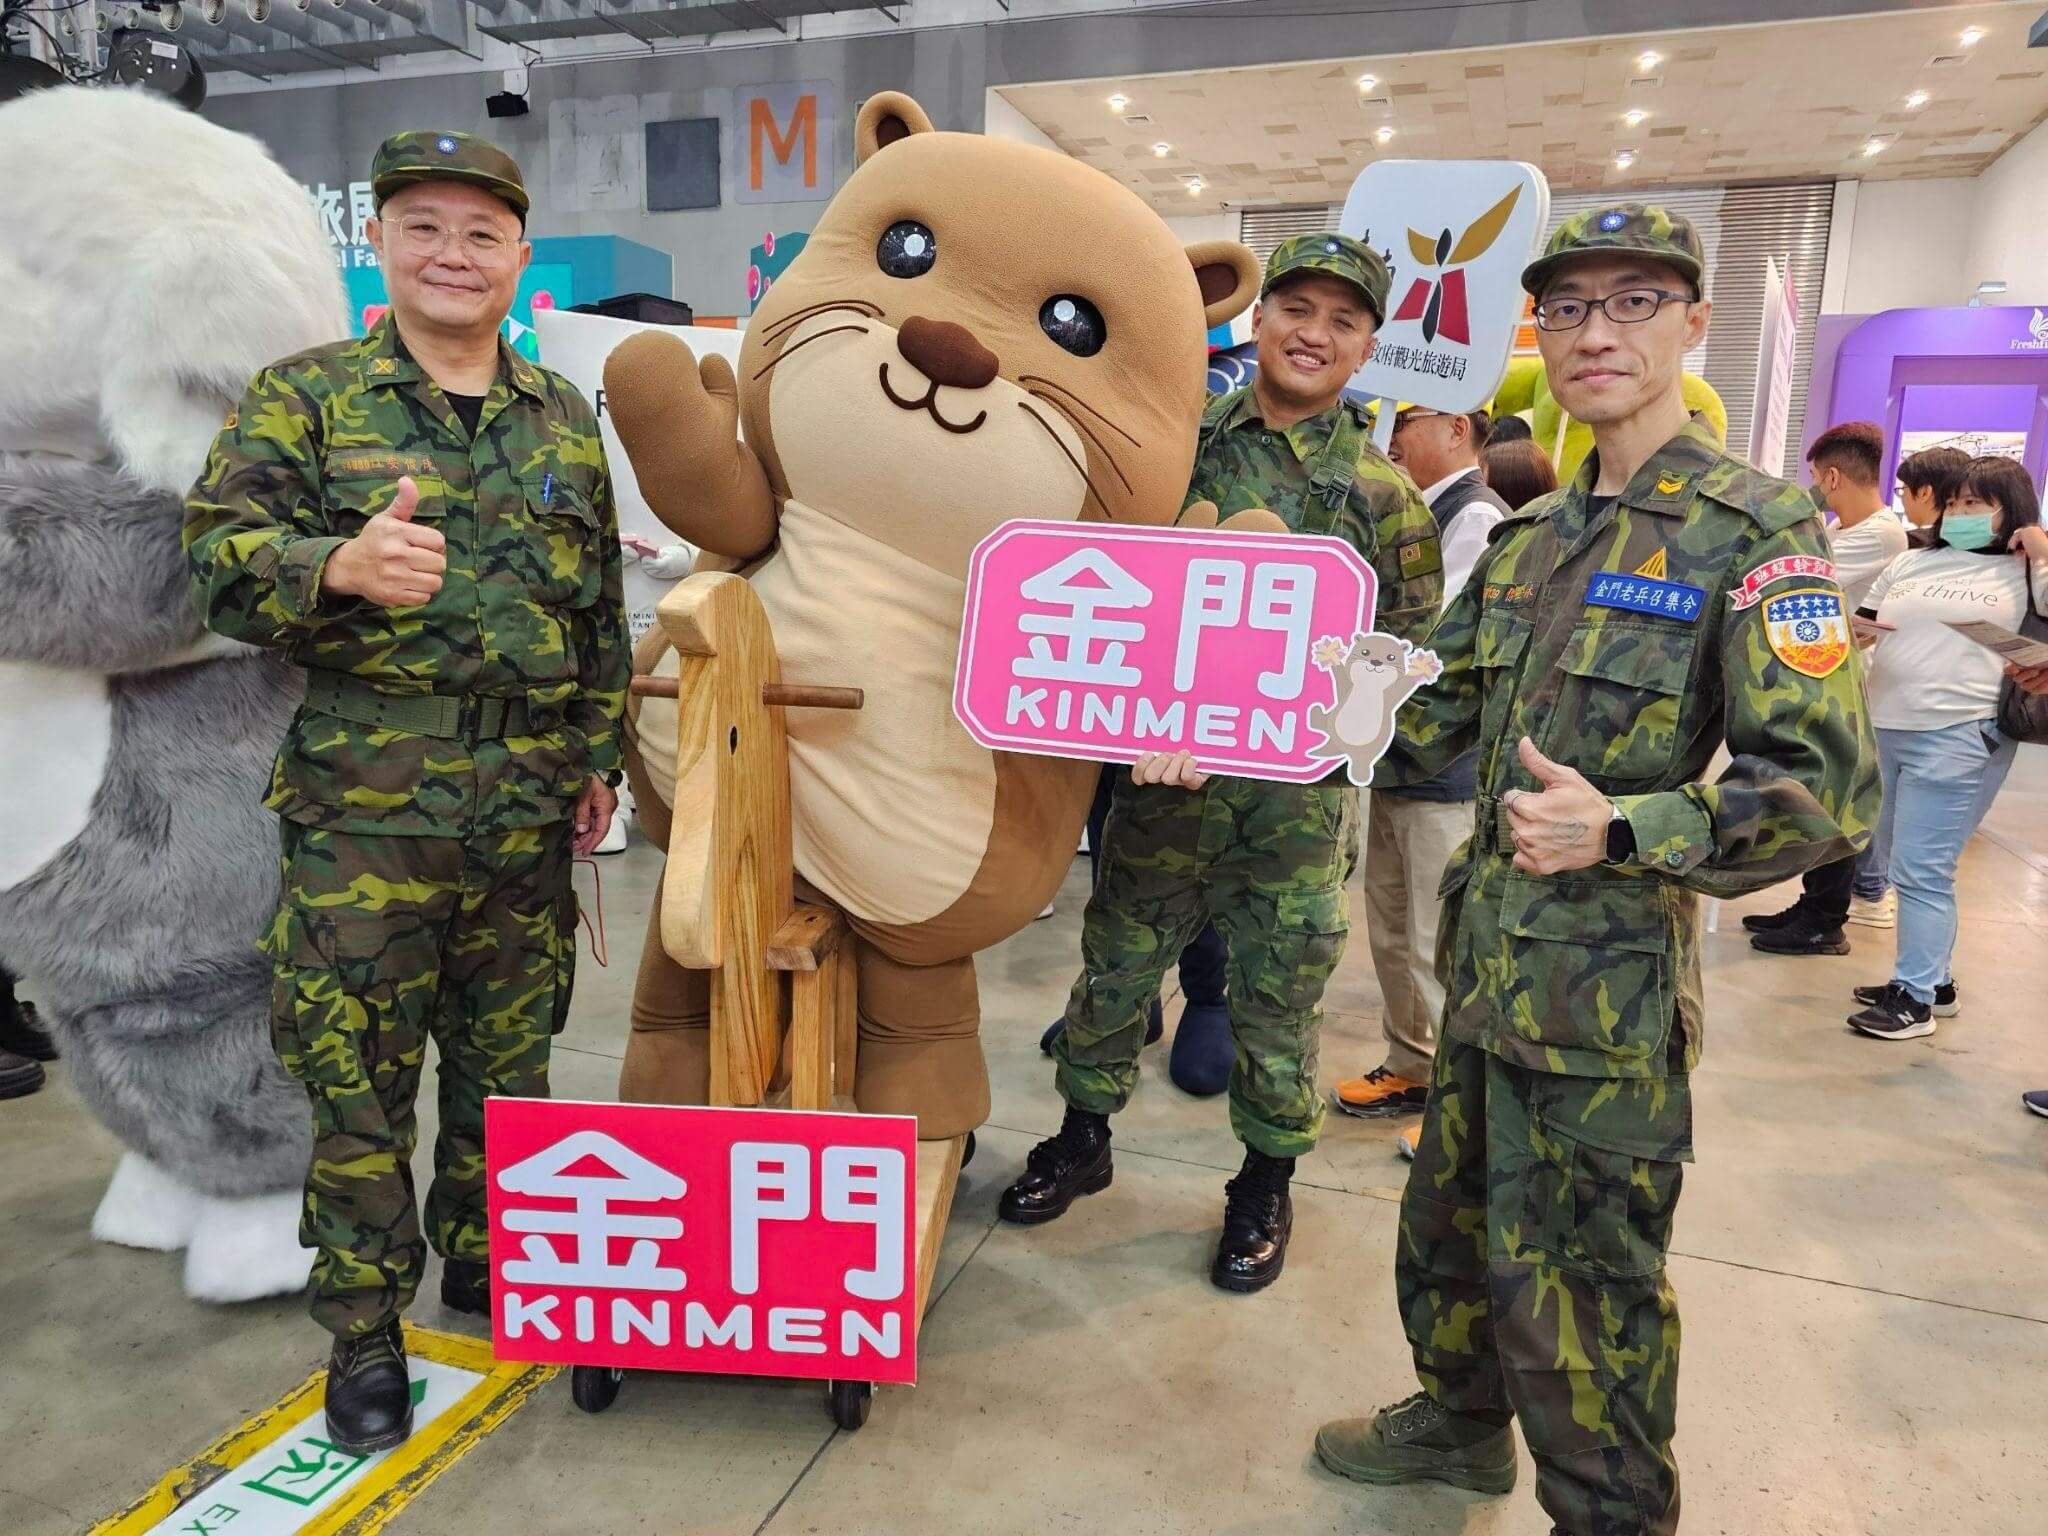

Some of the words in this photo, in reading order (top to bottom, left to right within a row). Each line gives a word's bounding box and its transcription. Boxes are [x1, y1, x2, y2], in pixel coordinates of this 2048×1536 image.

[749, 95, 817, 192] M
[354, 249, 380, 268] Fa
[1012, 547, 1317, 701] 金門
[1594, 579, 1697, 615] 金門老兵召集令
[1922, 584, 1998, 607] thrive
[1006, 685, 1297, 754] KINMEN
[496, 1130, 906, 1300] 金門
[503, 1292, 901, 1359] KINMEN
